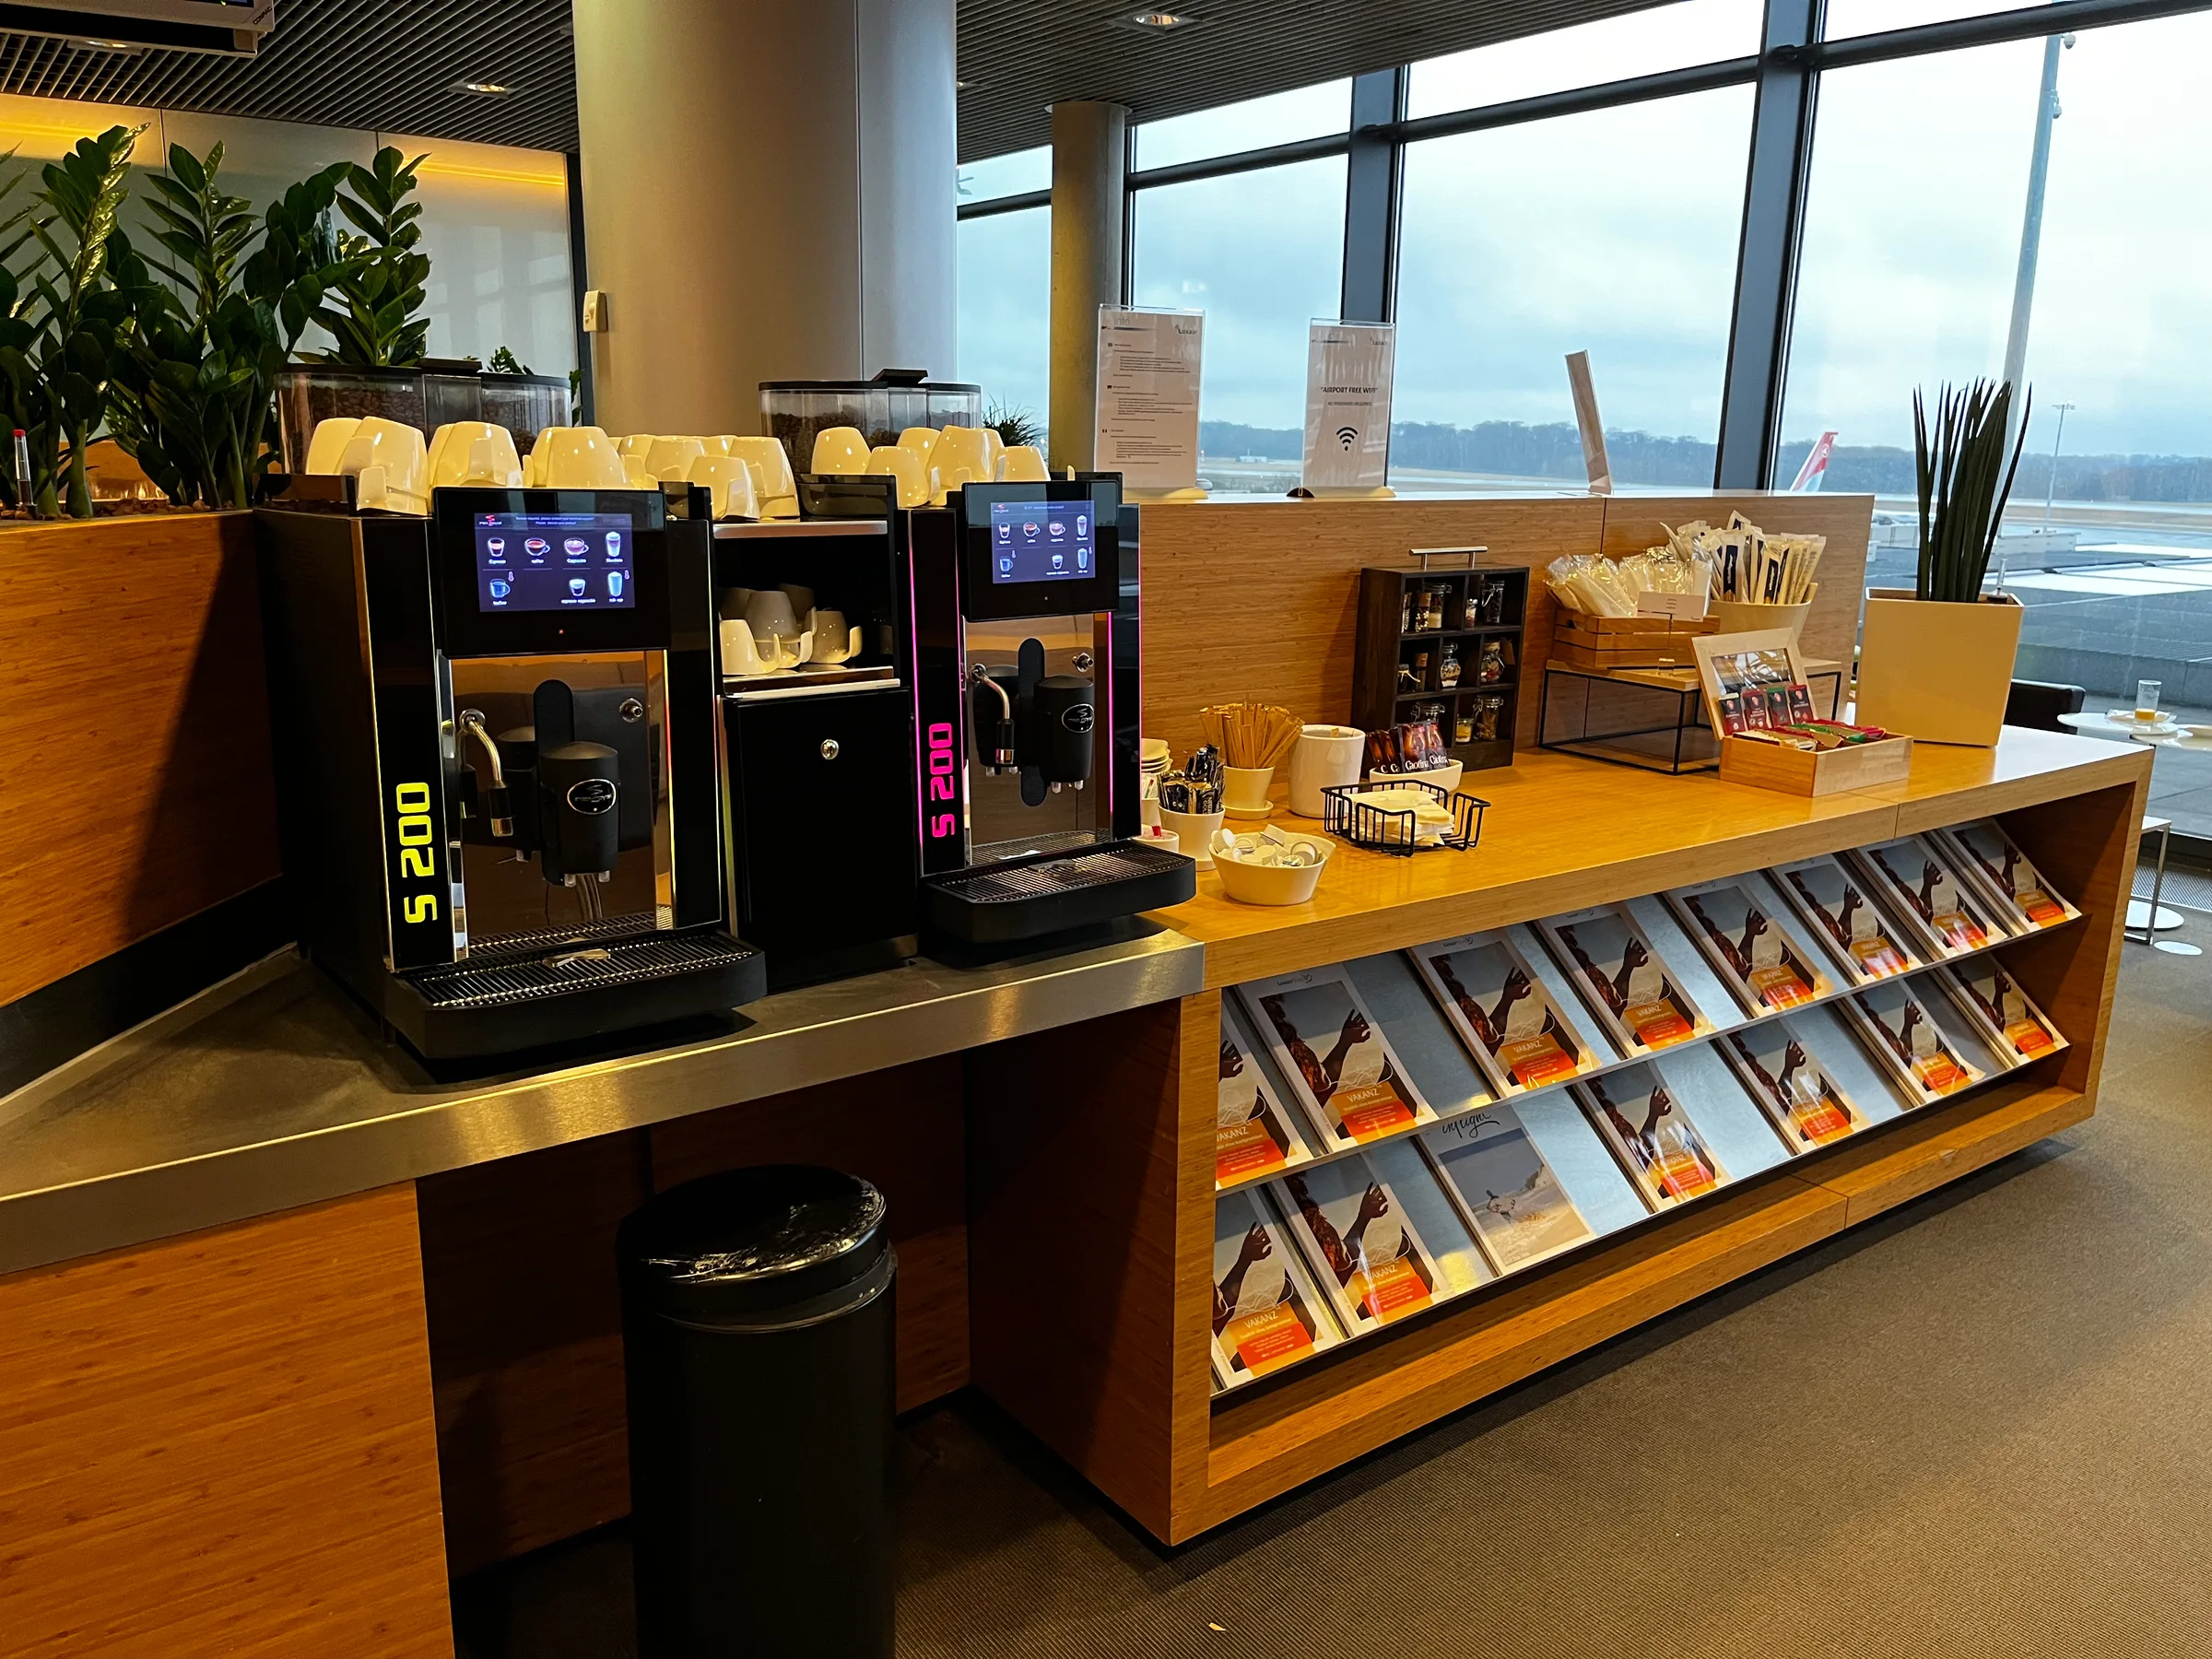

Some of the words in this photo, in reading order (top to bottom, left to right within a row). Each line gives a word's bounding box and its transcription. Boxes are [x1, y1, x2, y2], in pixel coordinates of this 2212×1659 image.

[928, 723, 955, 802] 200
[1405, 759, 1430, 771] Caotina
[395, 782, 435, 878] 200
[1512, 1040, 1543, 1053] VAKANZ
[1347, 1088, 1381, 1102] VAKANZ
[1370, 1264, 1398, 1279] AKANZ
[1244, 1310, 1279, 1328] VAKANZ
